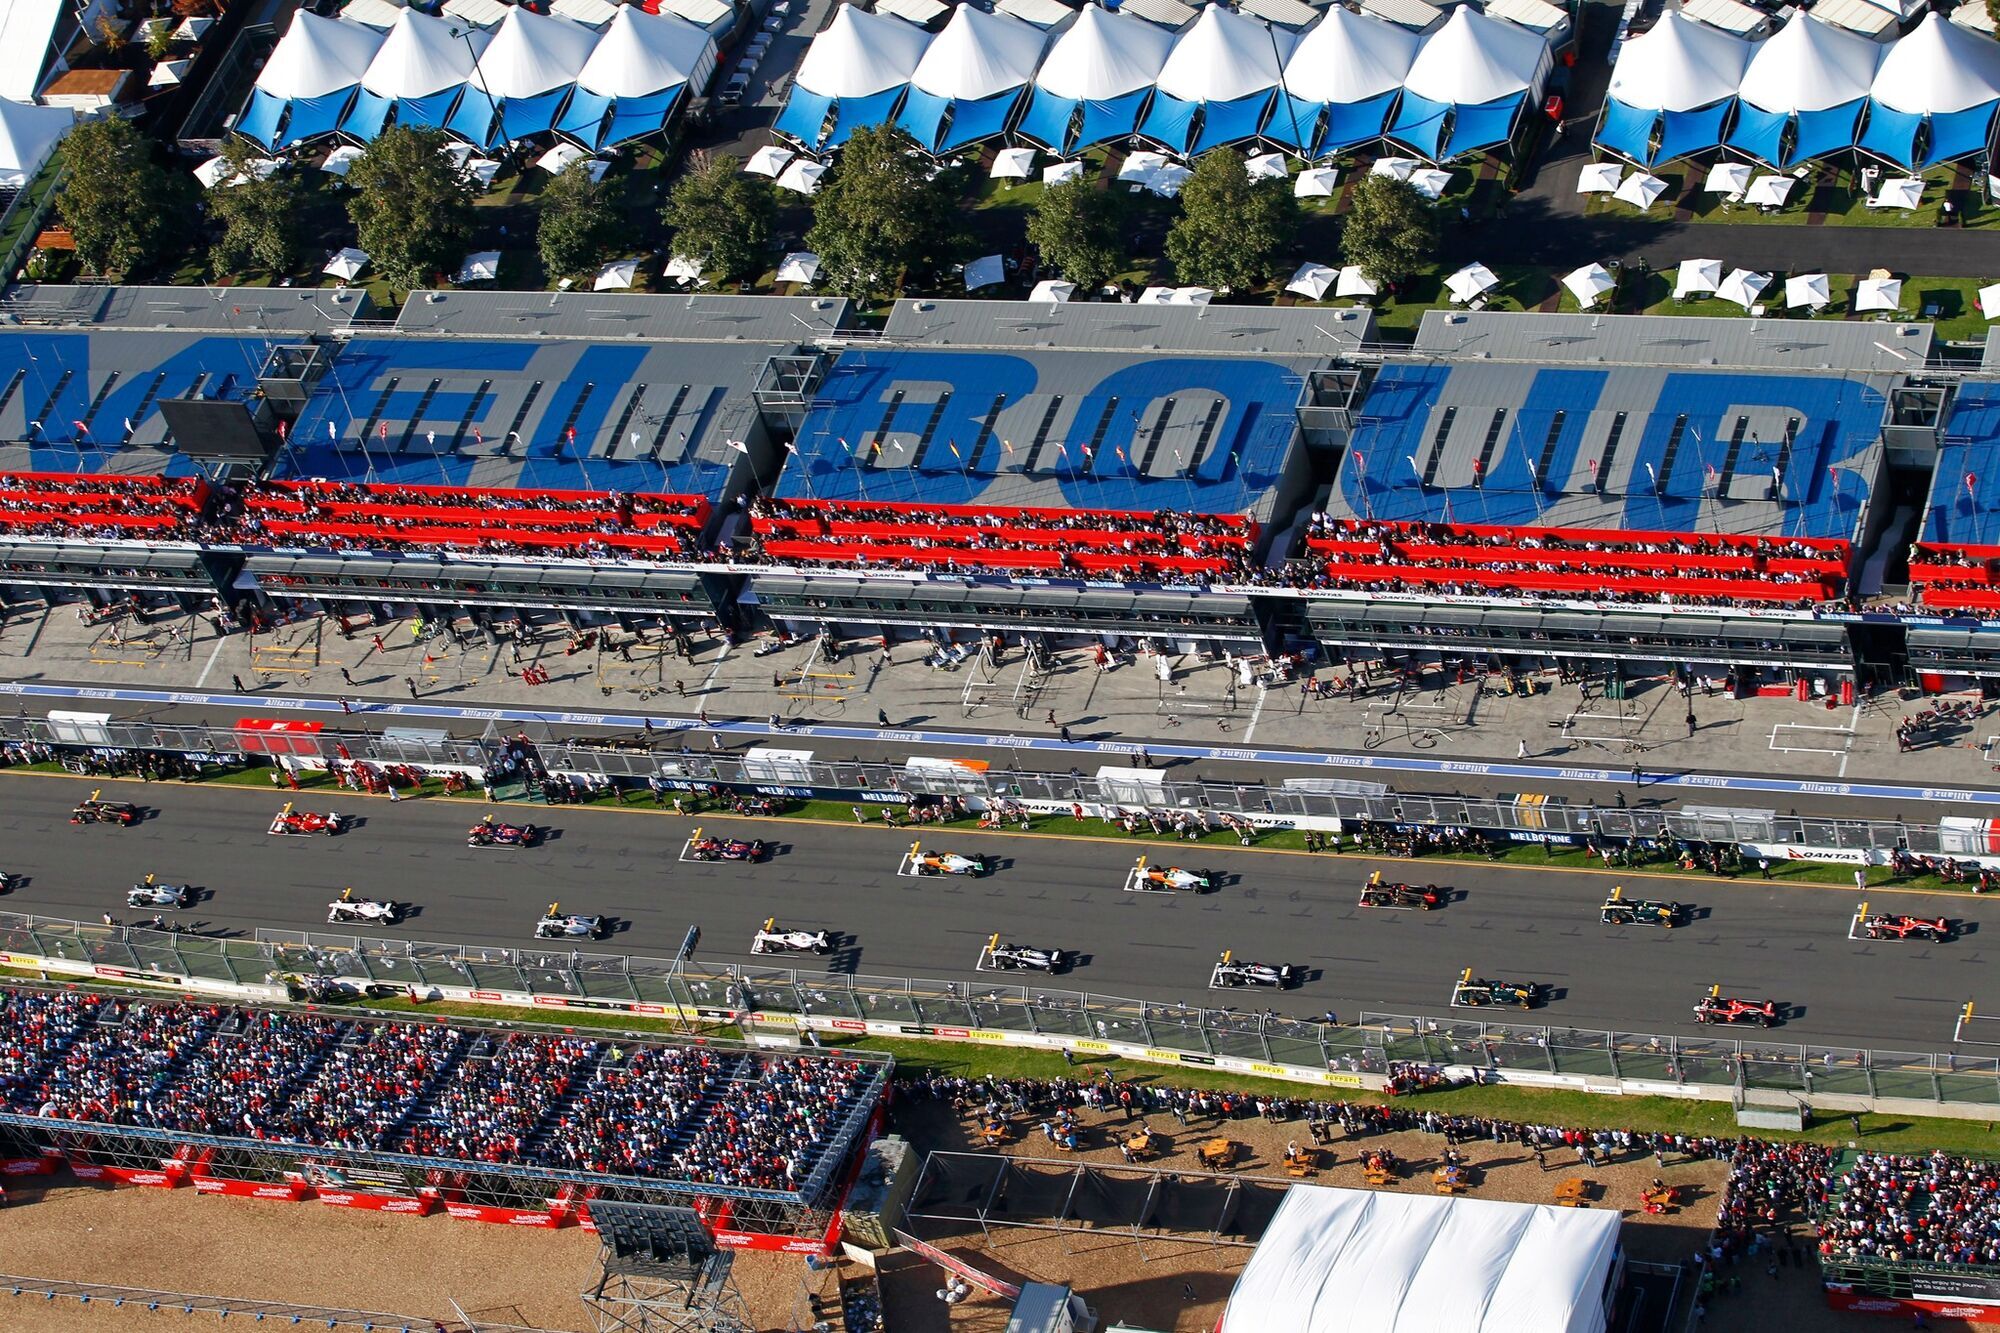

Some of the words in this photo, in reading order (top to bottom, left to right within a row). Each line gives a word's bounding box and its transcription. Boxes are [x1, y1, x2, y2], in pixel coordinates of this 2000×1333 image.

[76, 689, 105, 697] Allianz
[179, 694, 210, 702] Allianz
[264, 698, 295, 707] Allianz
[572, 715, 604, 724] Allianz
[876, 731, 911, 740] Allianz
[1097, 743, 1131, 751] Allianz
[1221, 750, 1257, 759] Allianz
[1324, 756, 1360, 764] Allianz
[1452, 762, 1489, 771] Allianz
[1559, 769, 1596, 778] Allianz
[1691, 777, 1728, 786] Allianz
[1799, 783, 1837, 792] Allianz
[1934, 791, 1973, 800] Allianz
[1803, 851, 1858, 860] QANTAS
